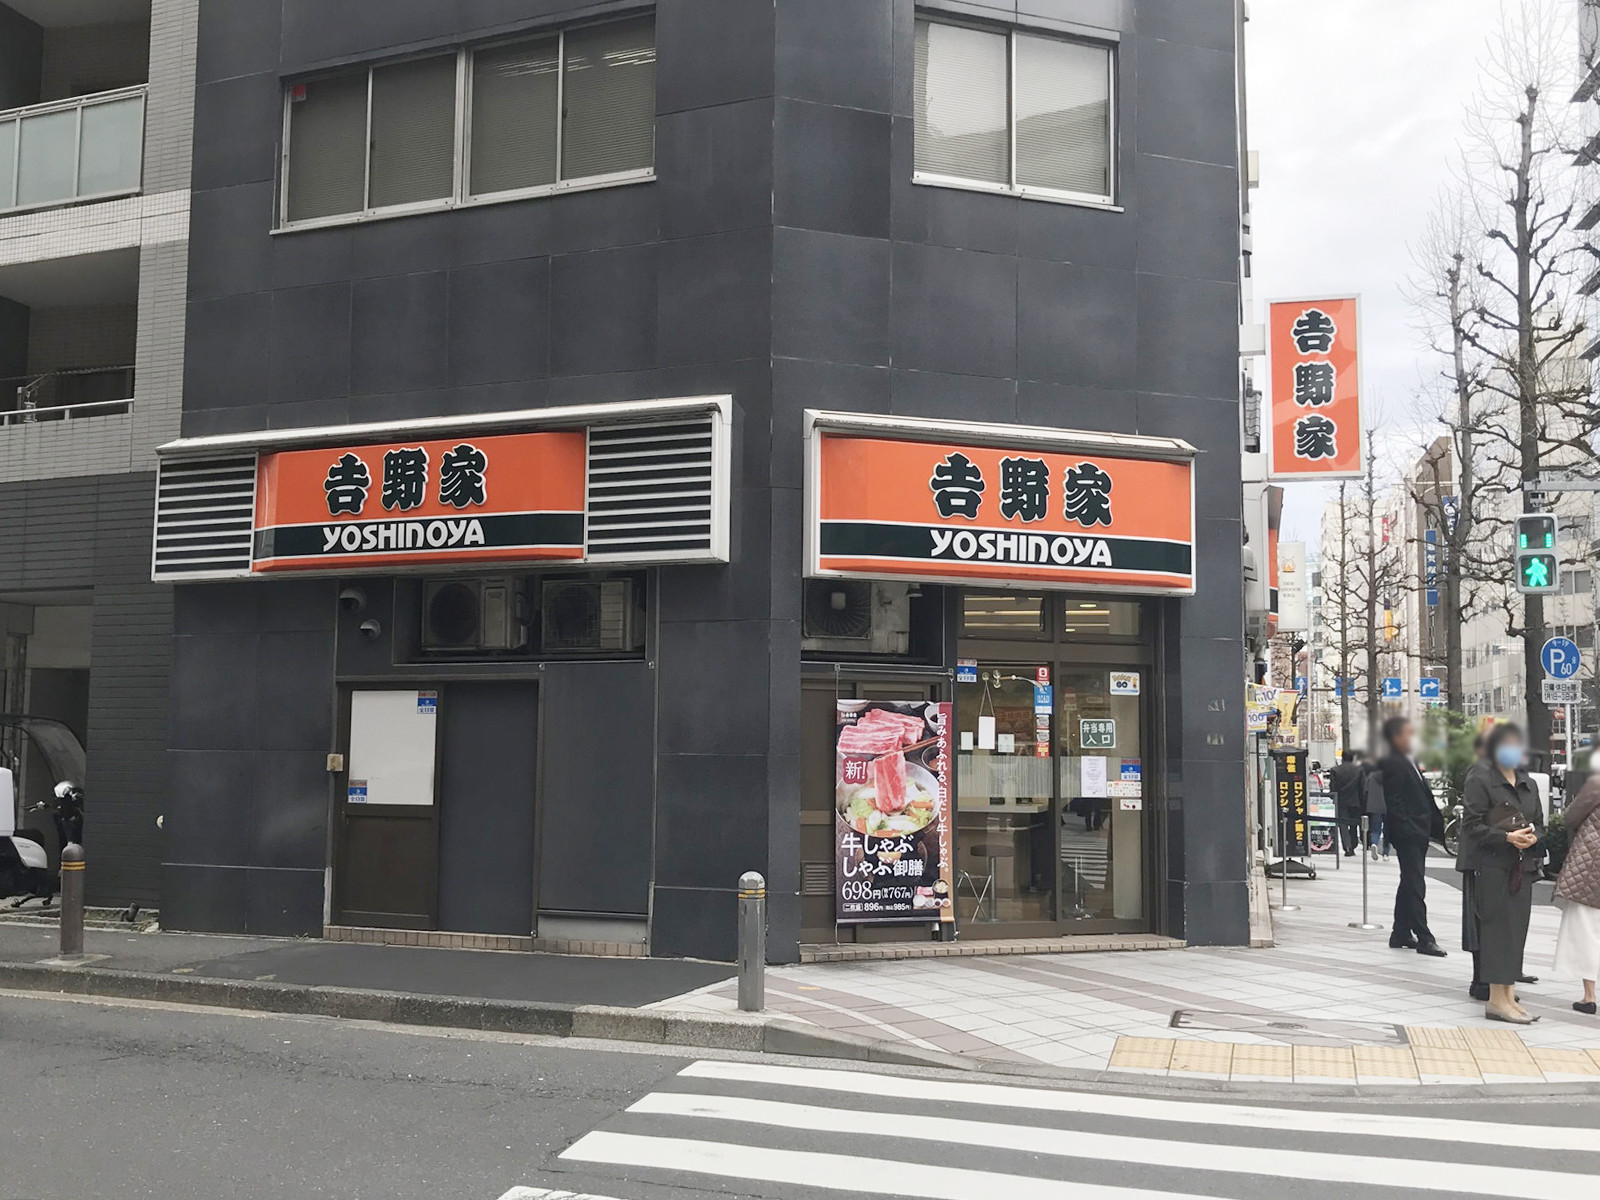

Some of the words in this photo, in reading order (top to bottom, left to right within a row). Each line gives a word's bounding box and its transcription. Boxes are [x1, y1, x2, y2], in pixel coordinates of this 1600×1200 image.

[1290, 308, 1337, 459] 吉野家
[323, 443, 488, 517] 吉野家
[928, 451, 1114, 529] 吉野家
[322, 519, 486, 552] YOSHINOYA
[930, 530, 1113, 567] YOSHINOYA
[1550, 649, 1566, 674] P
[1083, 722, 1113, 734] 弁当専用
[1086, 734, 1111, 745] 入口
[845, 761, 867, 779] 新!
[841, 832, 914, 856] 牛しゃぶ
[843, 856, 924, 877] しゃぶ御膳
